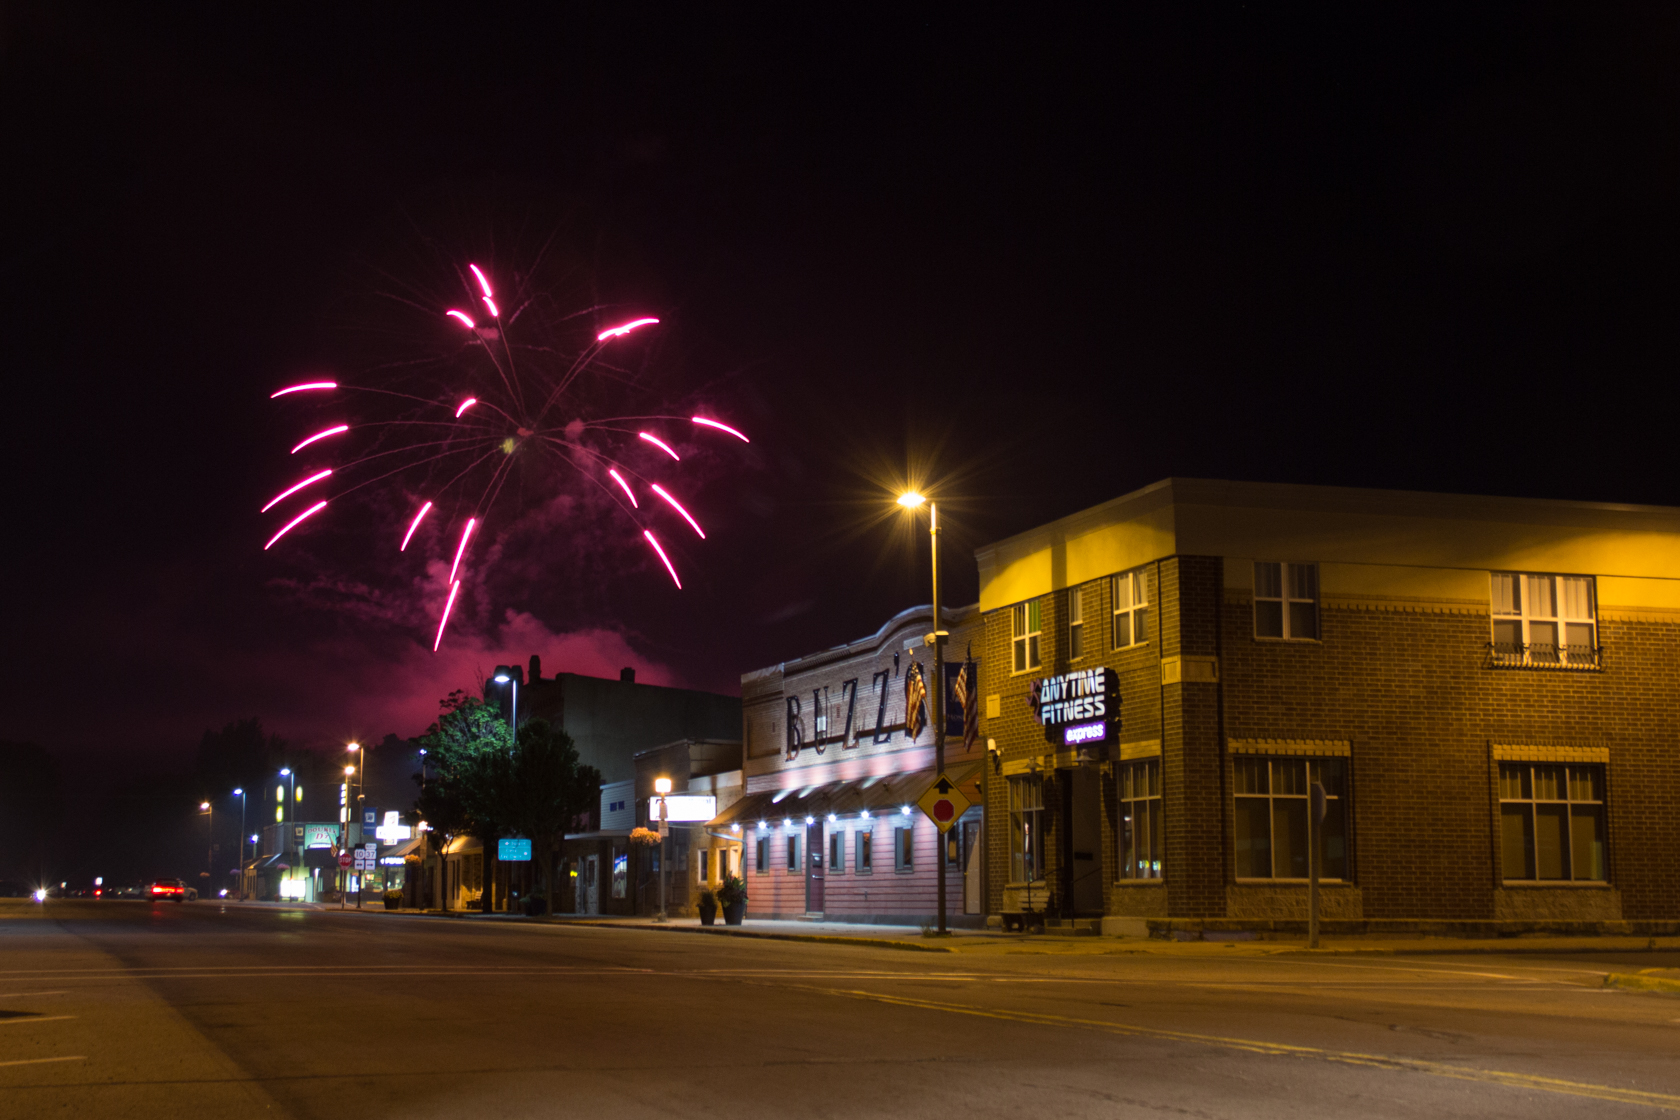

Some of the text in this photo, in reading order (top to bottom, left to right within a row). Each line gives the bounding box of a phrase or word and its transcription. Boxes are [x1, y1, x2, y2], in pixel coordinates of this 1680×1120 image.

[1040, 666, 1106, 704] ANYTIME
[1041, 694, 1106, 726] FITNESS
[1066, 724, 1104, 743] express
